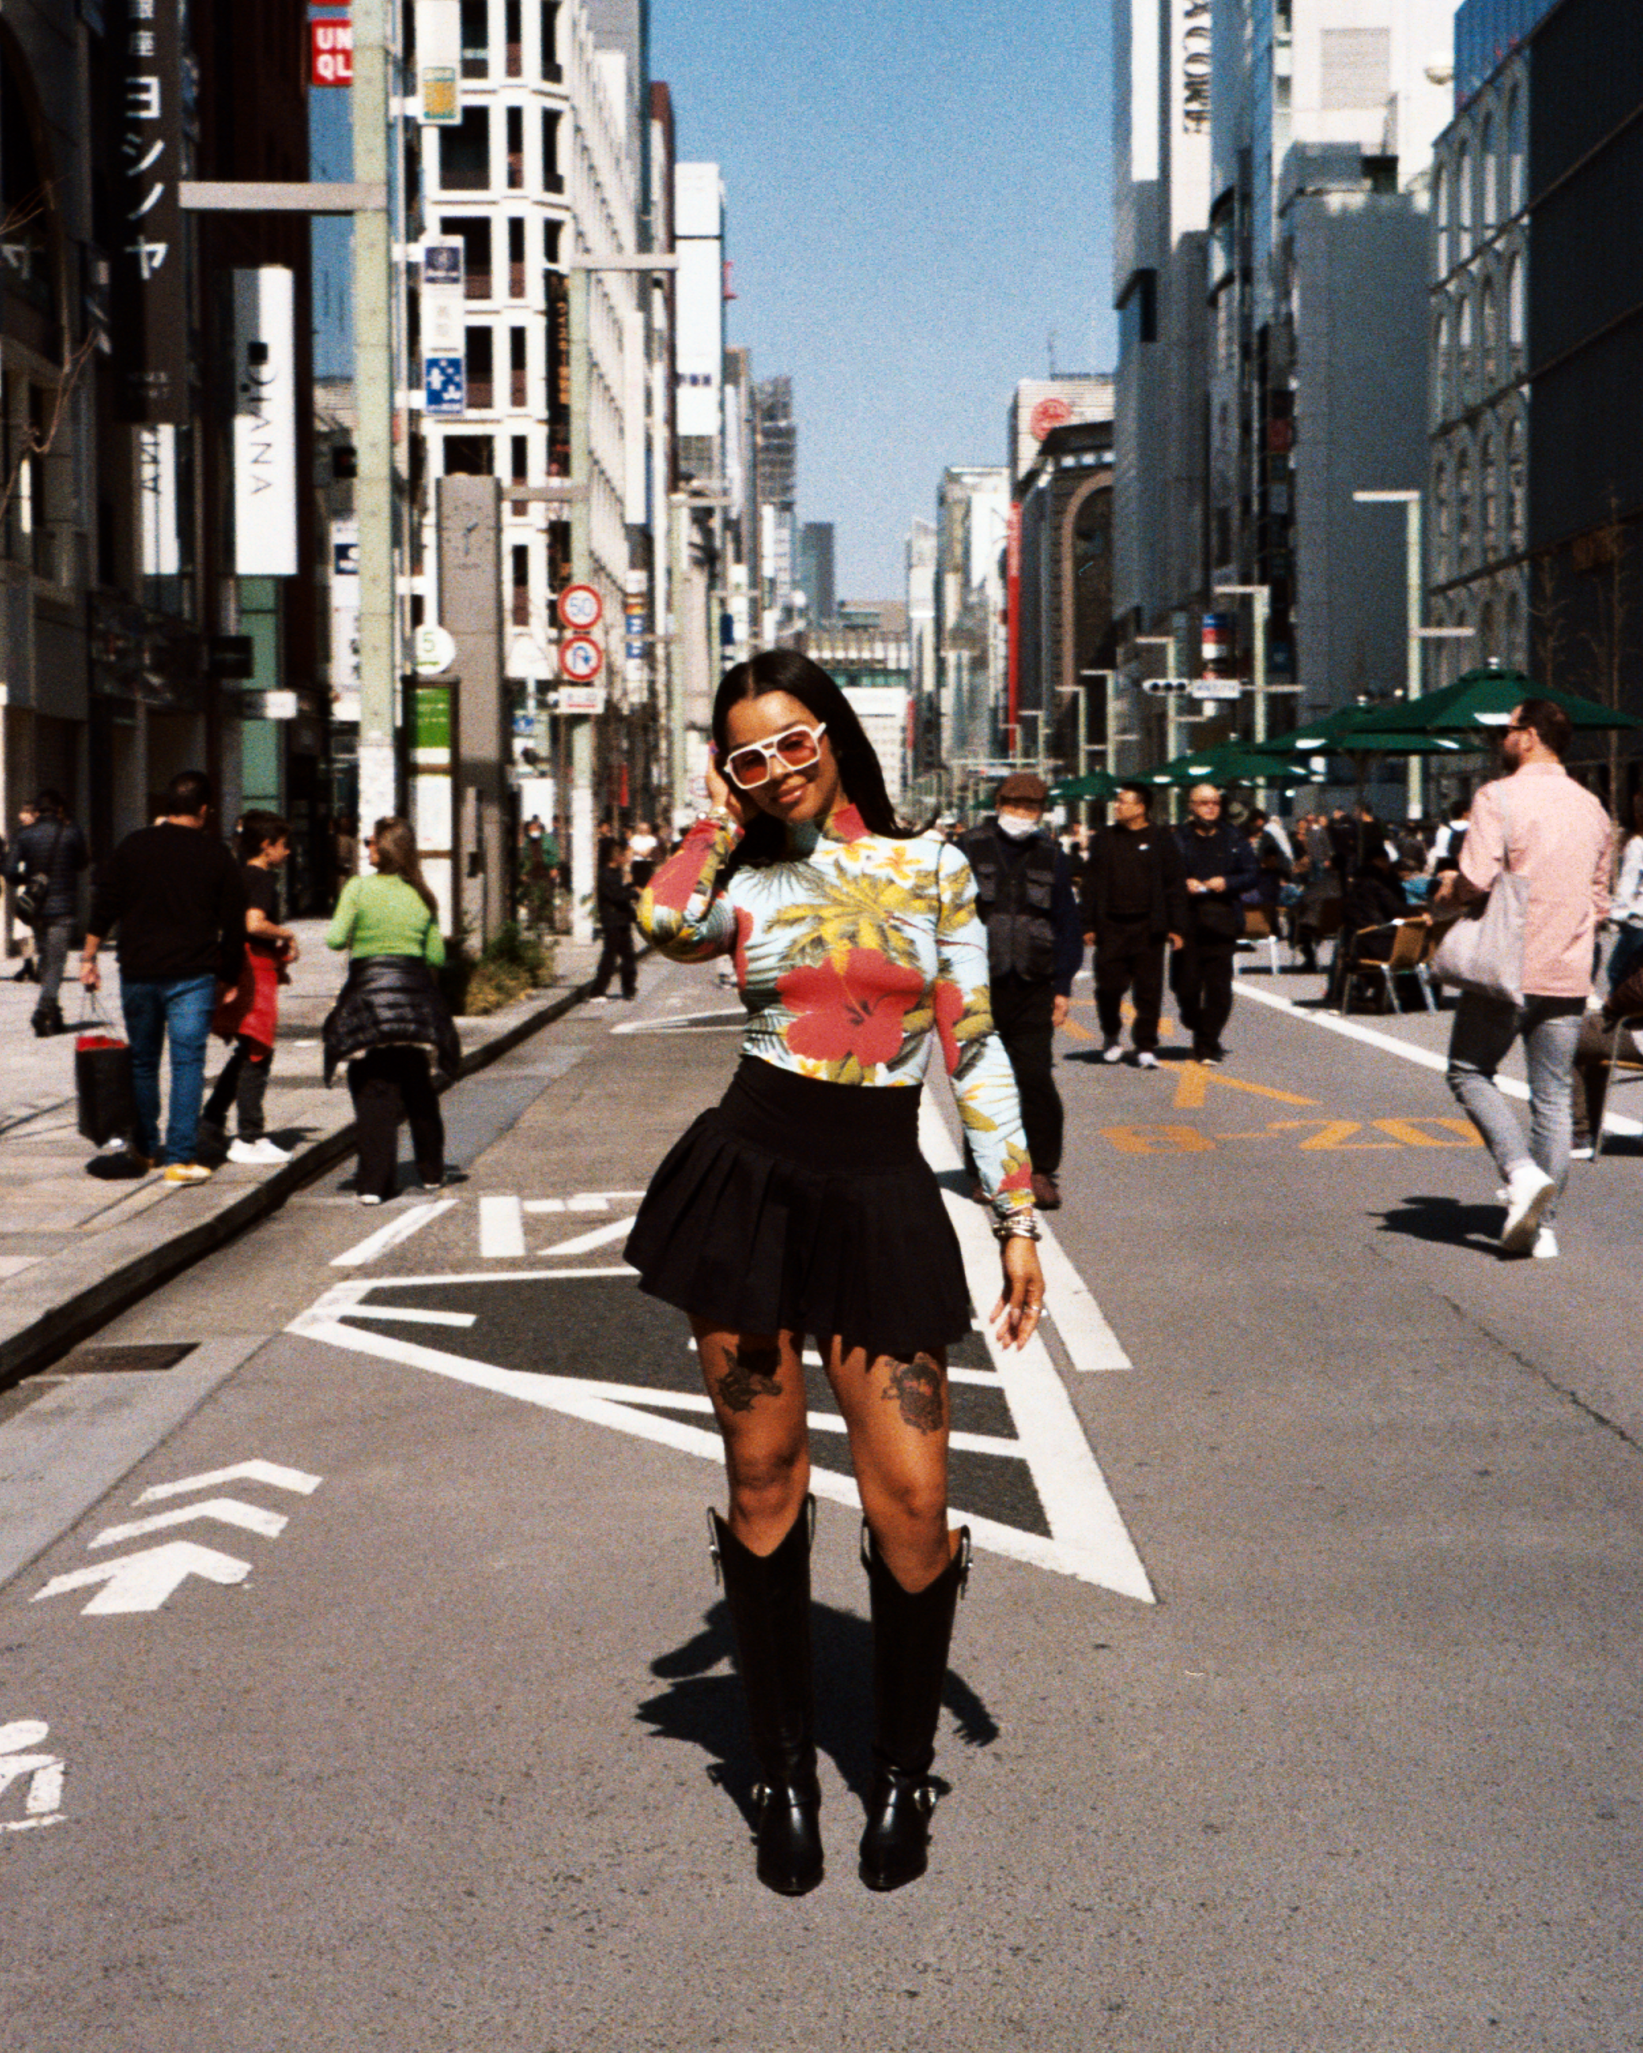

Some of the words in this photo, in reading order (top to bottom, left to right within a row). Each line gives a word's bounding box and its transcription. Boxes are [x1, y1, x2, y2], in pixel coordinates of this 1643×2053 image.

[122, 75, 168, 279] ヨシノヤ
[568, 596, 594, 618] 50
[422, 631, 436, 653] 5
